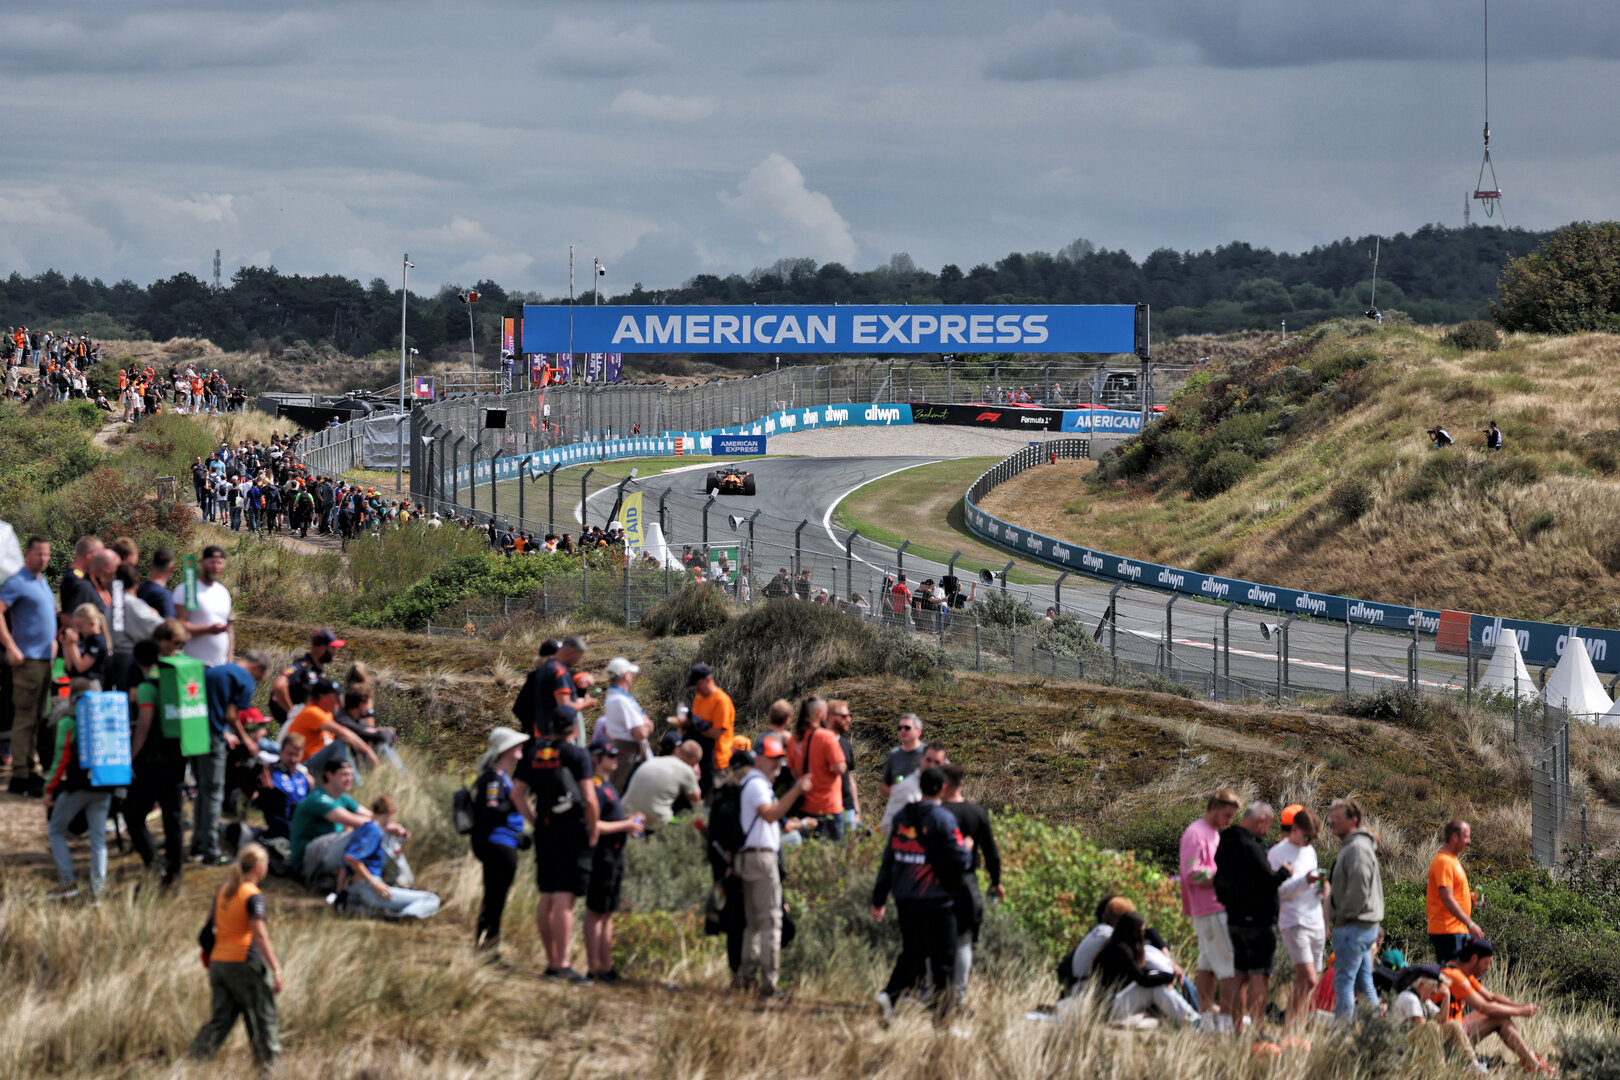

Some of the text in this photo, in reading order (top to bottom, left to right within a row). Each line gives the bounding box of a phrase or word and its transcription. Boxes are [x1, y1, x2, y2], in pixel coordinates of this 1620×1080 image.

[611, 315, 1049, 344] AMERICAN EXPRESS
[865, 404, 900, 425] allwyn
[1021, 416, 1044, 424] Formula
[1075, 415, 1140, 429] AMERICAN
[626, 507, 638, 533] AID
[1083, 551, 1103, 572] allwyn
[1118, 560, 1141, 580] allwyn
[1158, 569, 1184, 589] allwyn
[1201, 577, 1229, 597] allwyn
[1248, 585, 1276, 606] allwyn
[1296, 594, 1326, 614] allwyn
[1350, 602, 1384, 624] allwyn
[1482, 618, 1529, 652] alln
